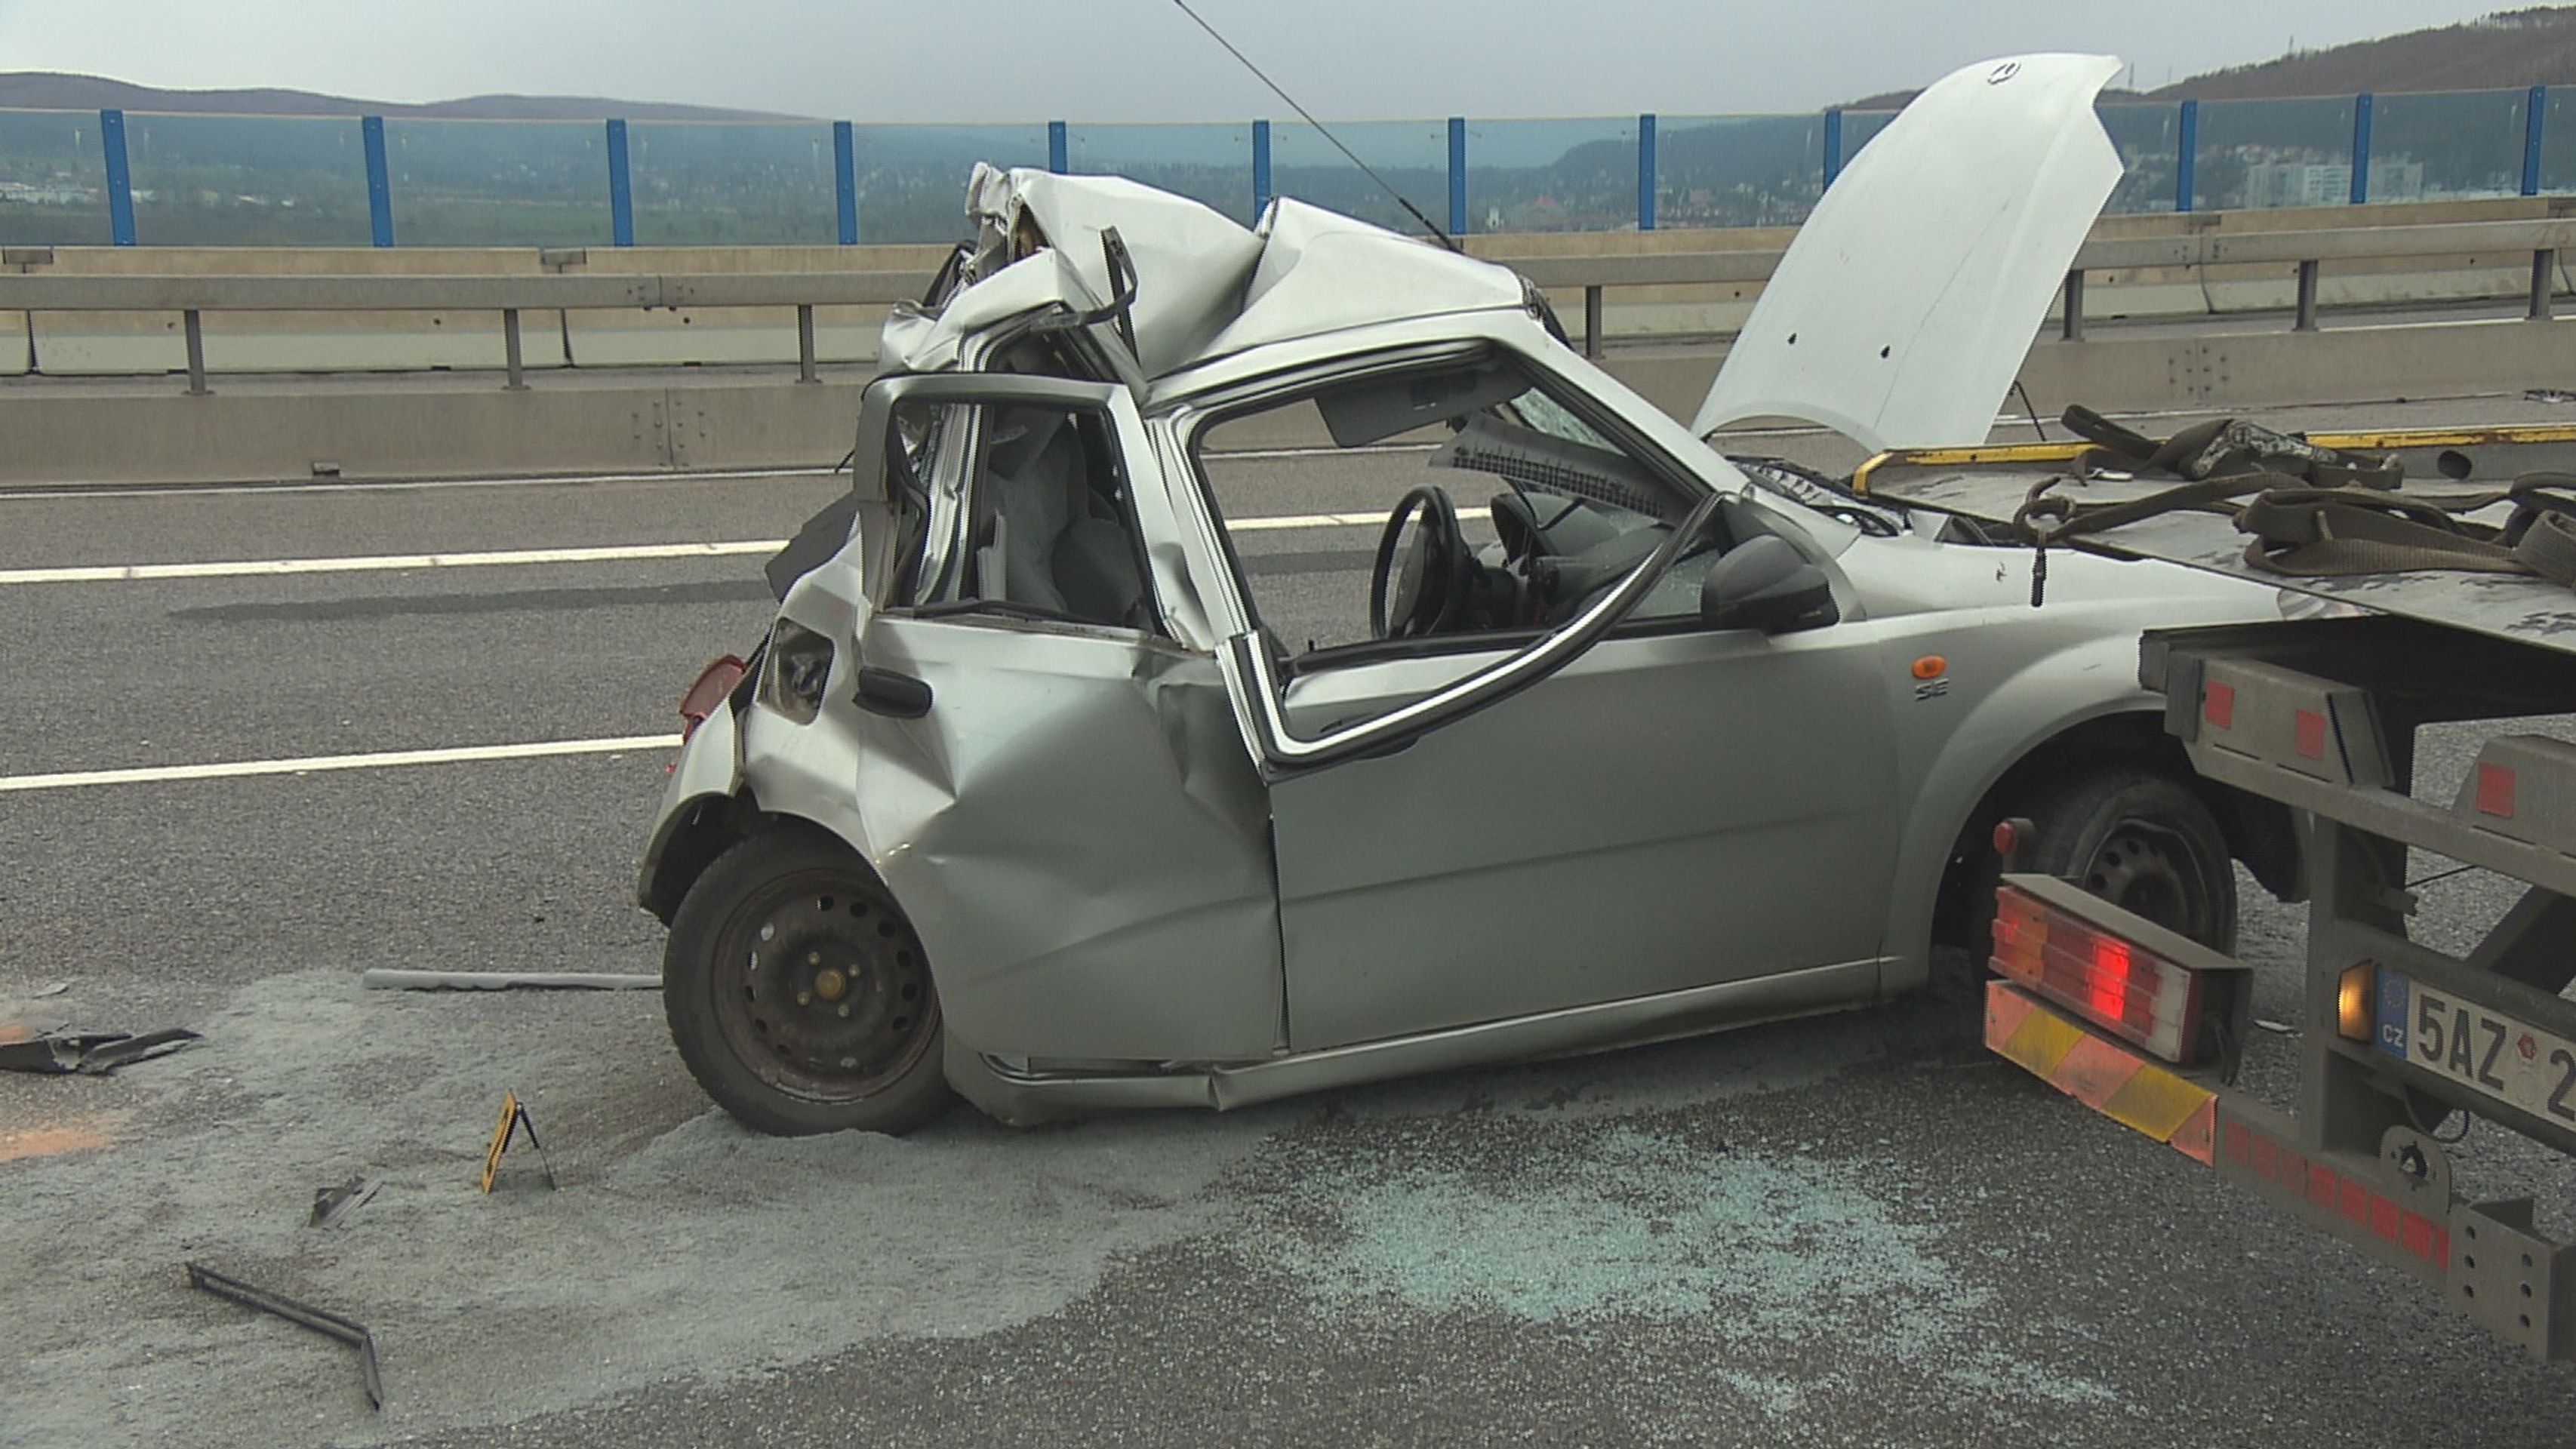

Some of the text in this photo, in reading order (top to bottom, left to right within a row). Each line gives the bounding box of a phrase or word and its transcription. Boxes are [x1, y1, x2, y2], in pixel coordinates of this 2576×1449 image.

[2382, 1023, 2404, 1048] CZ
[2418, 993, 2576, 1122] 5AZ 2
